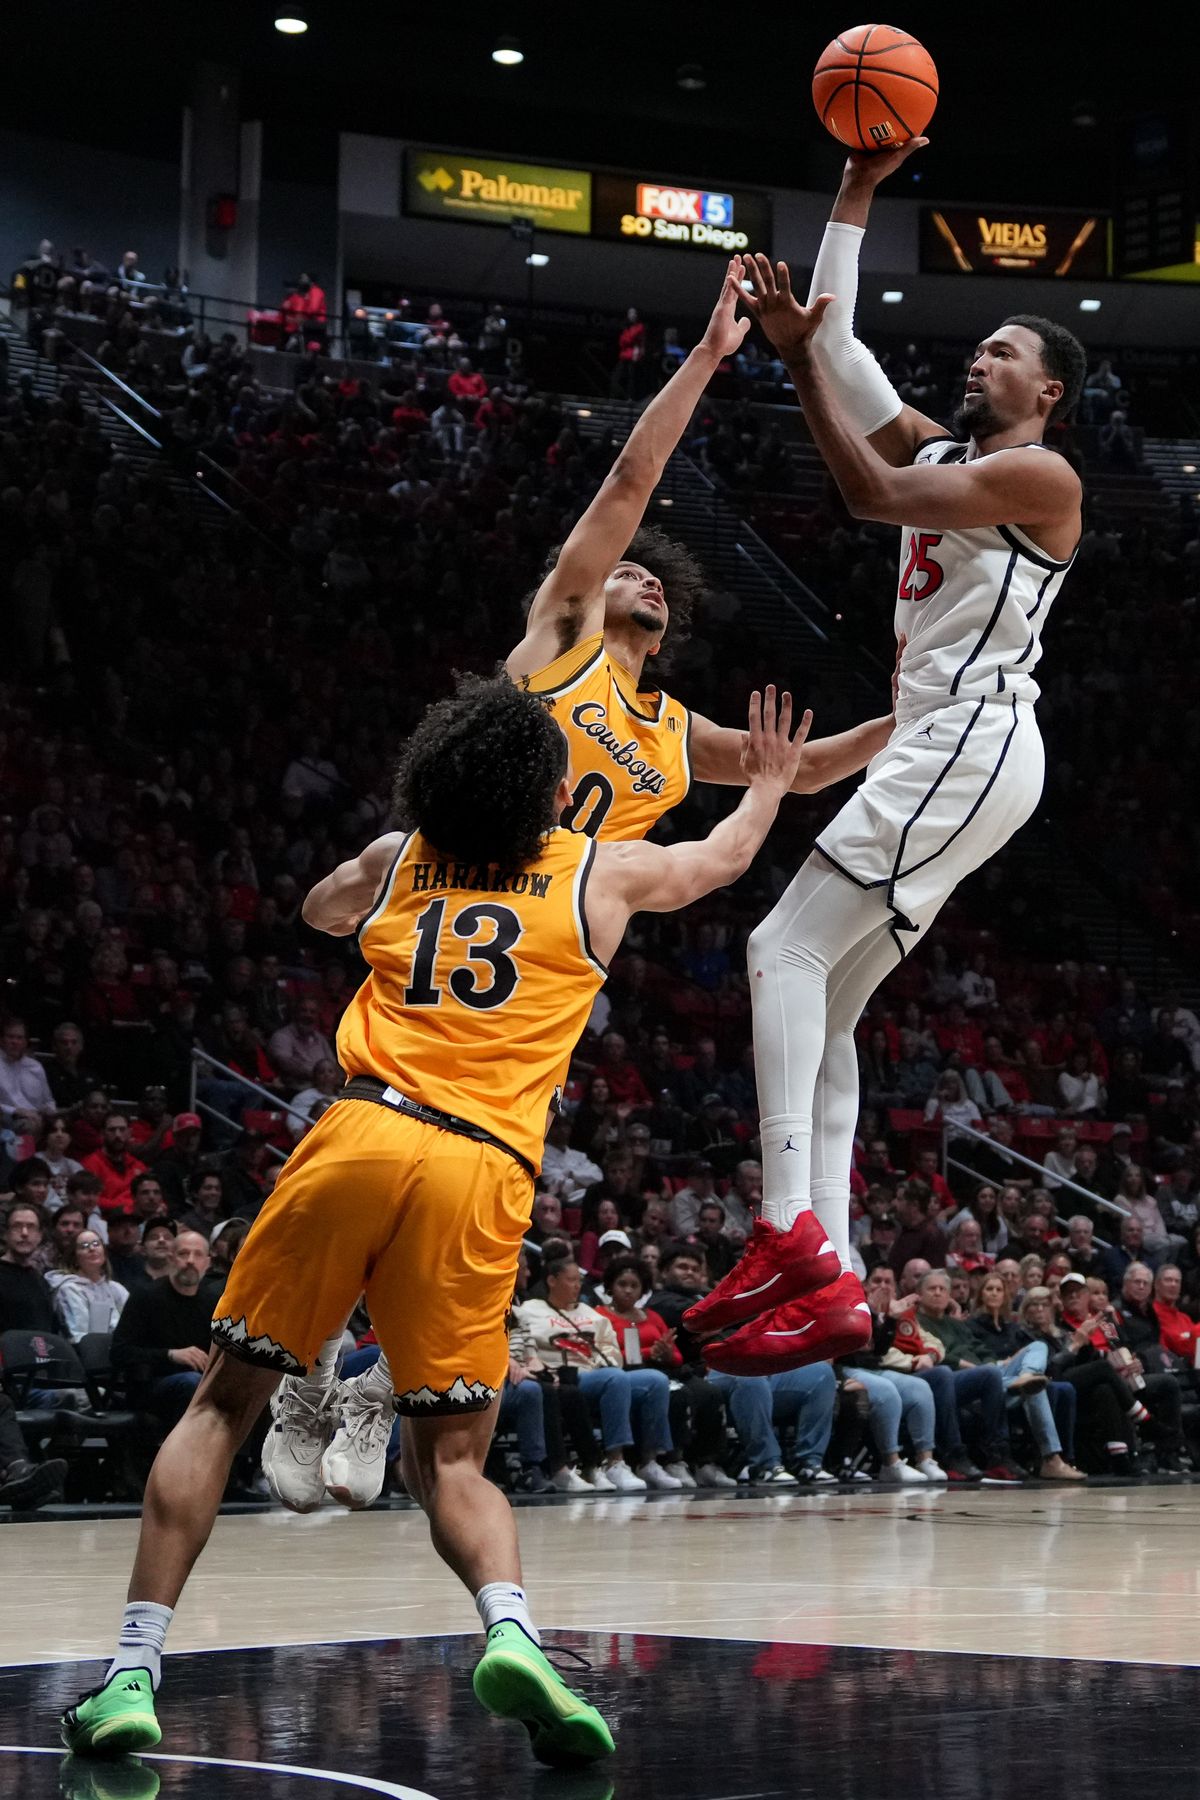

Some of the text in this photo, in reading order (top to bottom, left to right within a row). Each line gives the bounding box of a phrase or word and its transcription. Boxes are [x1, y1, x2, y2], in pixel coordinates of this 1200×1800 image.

[460, 169, 583, 210] Palomar
[641, 187, 726, 224] FOX 5
[653, 218, 690, 241] San
[691, 223, 749, 250] Diego
[978, 217, 1047, 248] VIEJAS
[899, 531, 944, 601] 25
[570, 702, 667, 796] Cowboys
[559, 771, 614, 839] 0
[411, 862, 553, 898] HARAKOW
[402, 898, 526, 1011] 13
